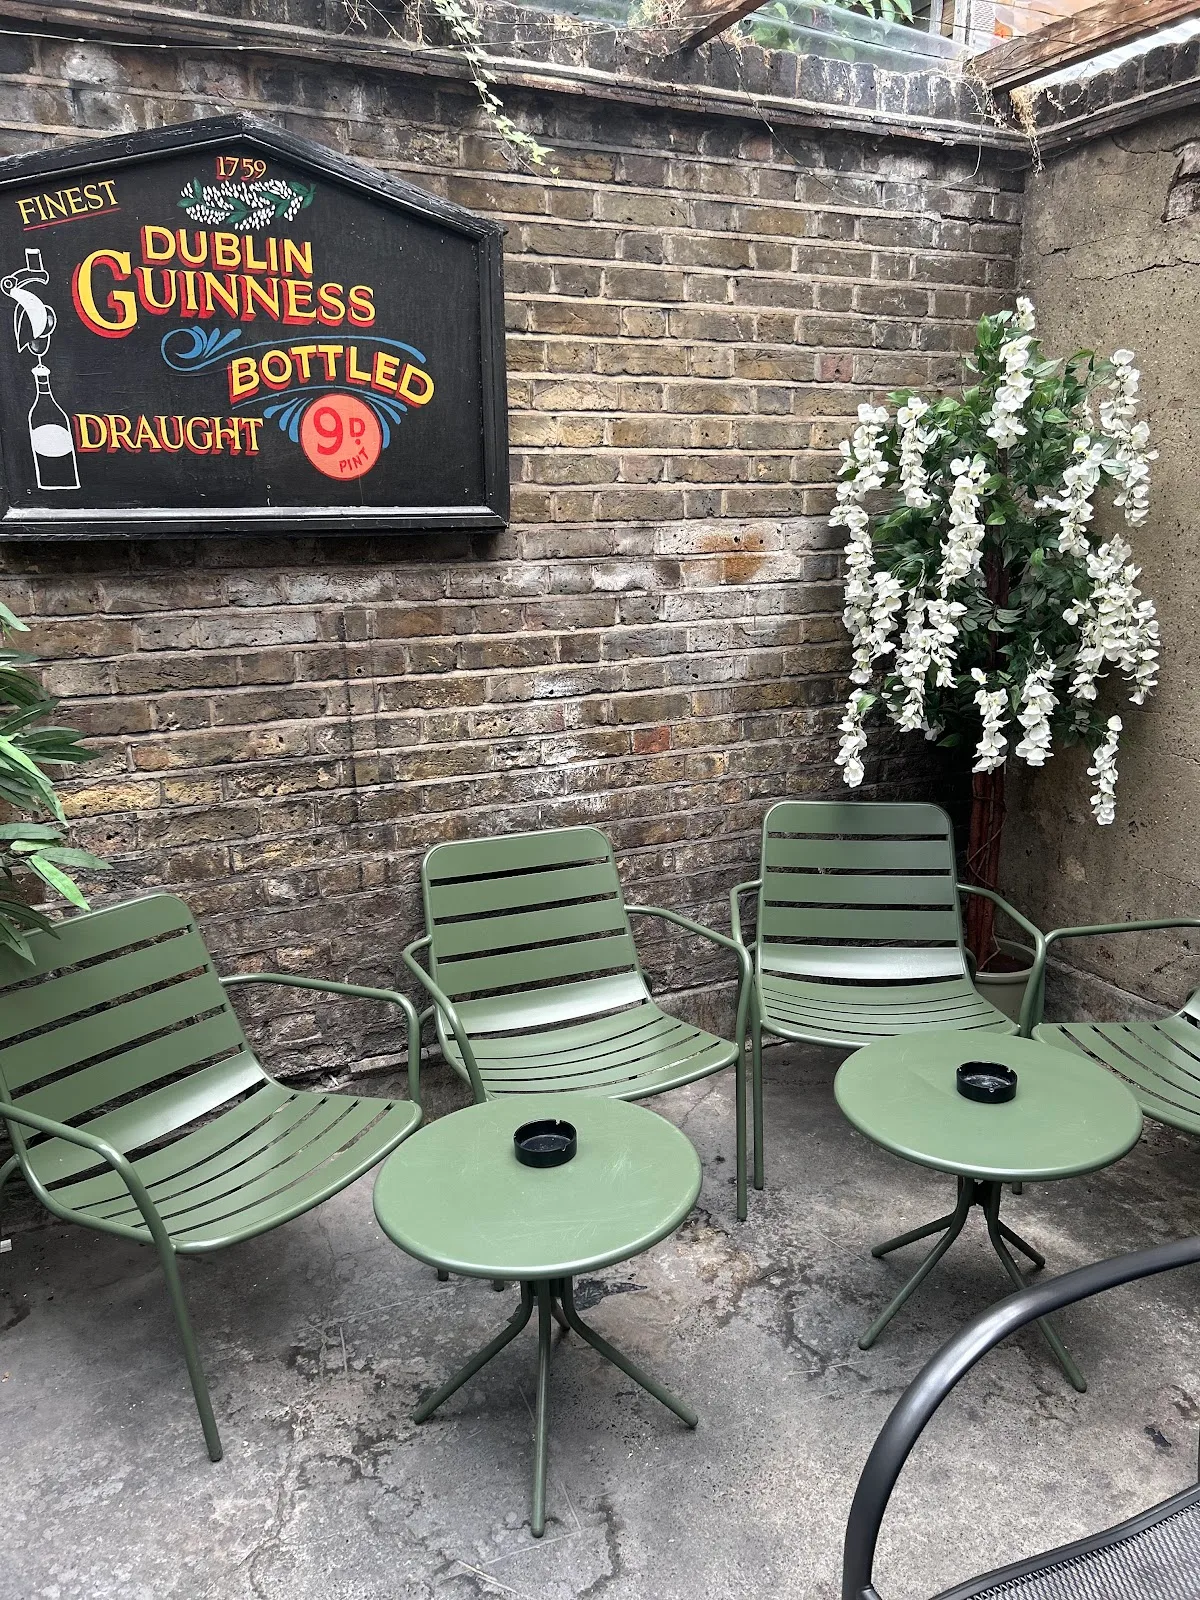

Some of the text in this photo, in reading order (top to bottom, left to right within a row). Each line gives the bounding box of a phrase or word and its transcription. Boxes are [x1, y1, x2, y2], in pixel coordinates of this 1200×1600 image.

[216, 156, 267, 180] 1759
[15, 180, 118, 225] FINEST
[140, 225, 313, 276] DUBLIN
[227, 345, 435, 407] BOTTLED
[74, 414, 264, 456] DRAUGHT
[338, 446, 370, 473] PINT
